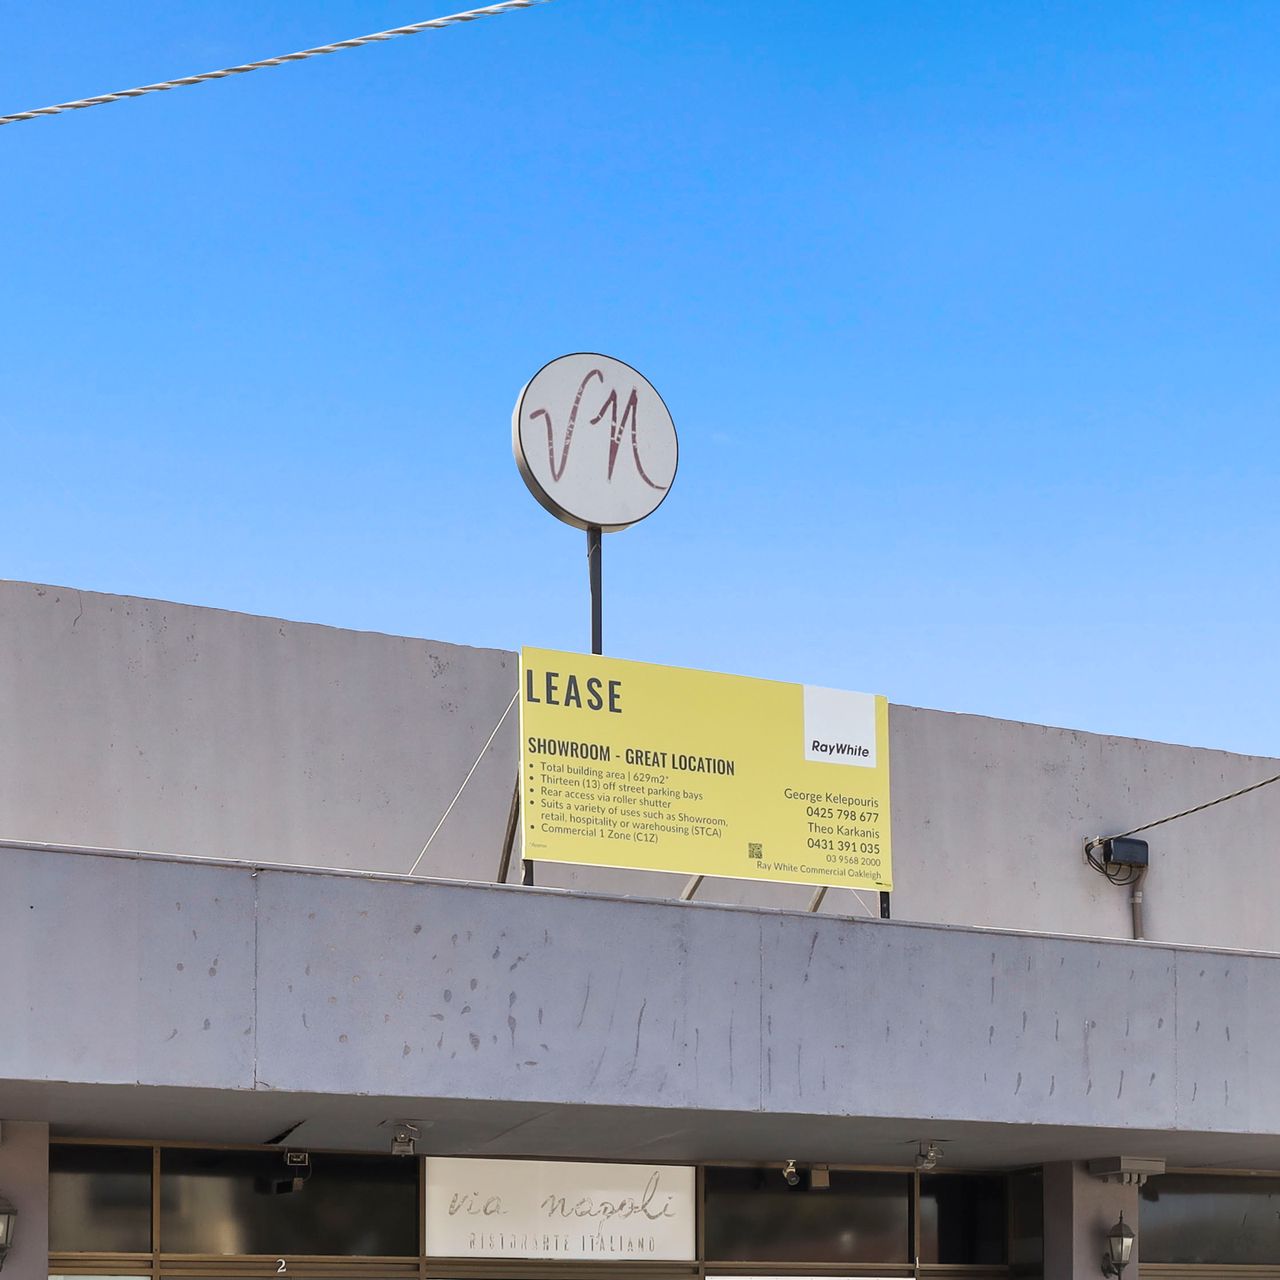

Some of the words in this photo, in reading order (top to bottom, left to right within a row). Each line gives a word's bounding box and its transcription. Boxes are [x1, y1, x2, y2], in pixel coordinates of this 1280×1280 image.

[526, 668, 622, 713] LEASE
[528, 737, 610, 762] SHOWROOM
[625, 748, 667, 768] GREAT
[671, 753, 735, 776] LOCATION
[811, 740, 870, 758] RayWhite
[540, 761, 564, 773] Total
[566, 764, 604, 779] building
[605, 771, 626, 780] area
[541, 774, 580, 787] Thirteen
[582, 779, 601, 790] (13)
[602, 782, 616, 791] off
[618, 784, 645, 794] street
[647, 788, 681, 799] parking
[682, 790, 703, 801] bays
[541, 786, 562, 797] Rear
[565, 791, 595, 801] access
[597, 794, 611, 803] via
[613, 795, 637, 805] roller
[639, 797, 672, 809] shutter
[784, 788, 823, 803] George
[825, 792, 879, 808] Kelepouris
[541, 798, 564, 810] Suits
[574, 803, 606, 815] variety
[608, 806, 619, 815] of
[620, 809, 641, 817] uses
[643, 810, 664, 820] such
[678, 812, 728, 827] Showroom,
[806, 806, 833, 819] 0425
[836, 809, 857, 821] 798
[859, 811, 879, 823] 677
[541, 822, 597, 837] Commercial
[608, 829, 631, 841] Zone
[633, 832, 659, 844] (C1Z)
[569, 814, 618, 828] hospitality
[619, 820, 630, 828] or
[632, 822, 690, 836] warehousing
[691, 825, 722, 839] (STCA)
[807, 821, 834, 835] Theo
[836, 825, 880, 839] Karkanis
[807, 838, 834, 850] 0431
[837, 841, 857, 853] 391
[860, 843, 880, 854] 035
[826, 854, 837, 863] 03
[839, 855, 859, 865] 9568
[860, 857, 881, 867] 2000
[756, 861, 772, 872] Ray
[774, 862, 798, 872] White
[800, 865, 846, 877] Commercial
[847, 868, 882, 880] Oakleigh
[447, 1191, 509, 1216] via
[581, 1234, 656, 1252] ITALIANO
[276, 1259, 287, 1273] 2
